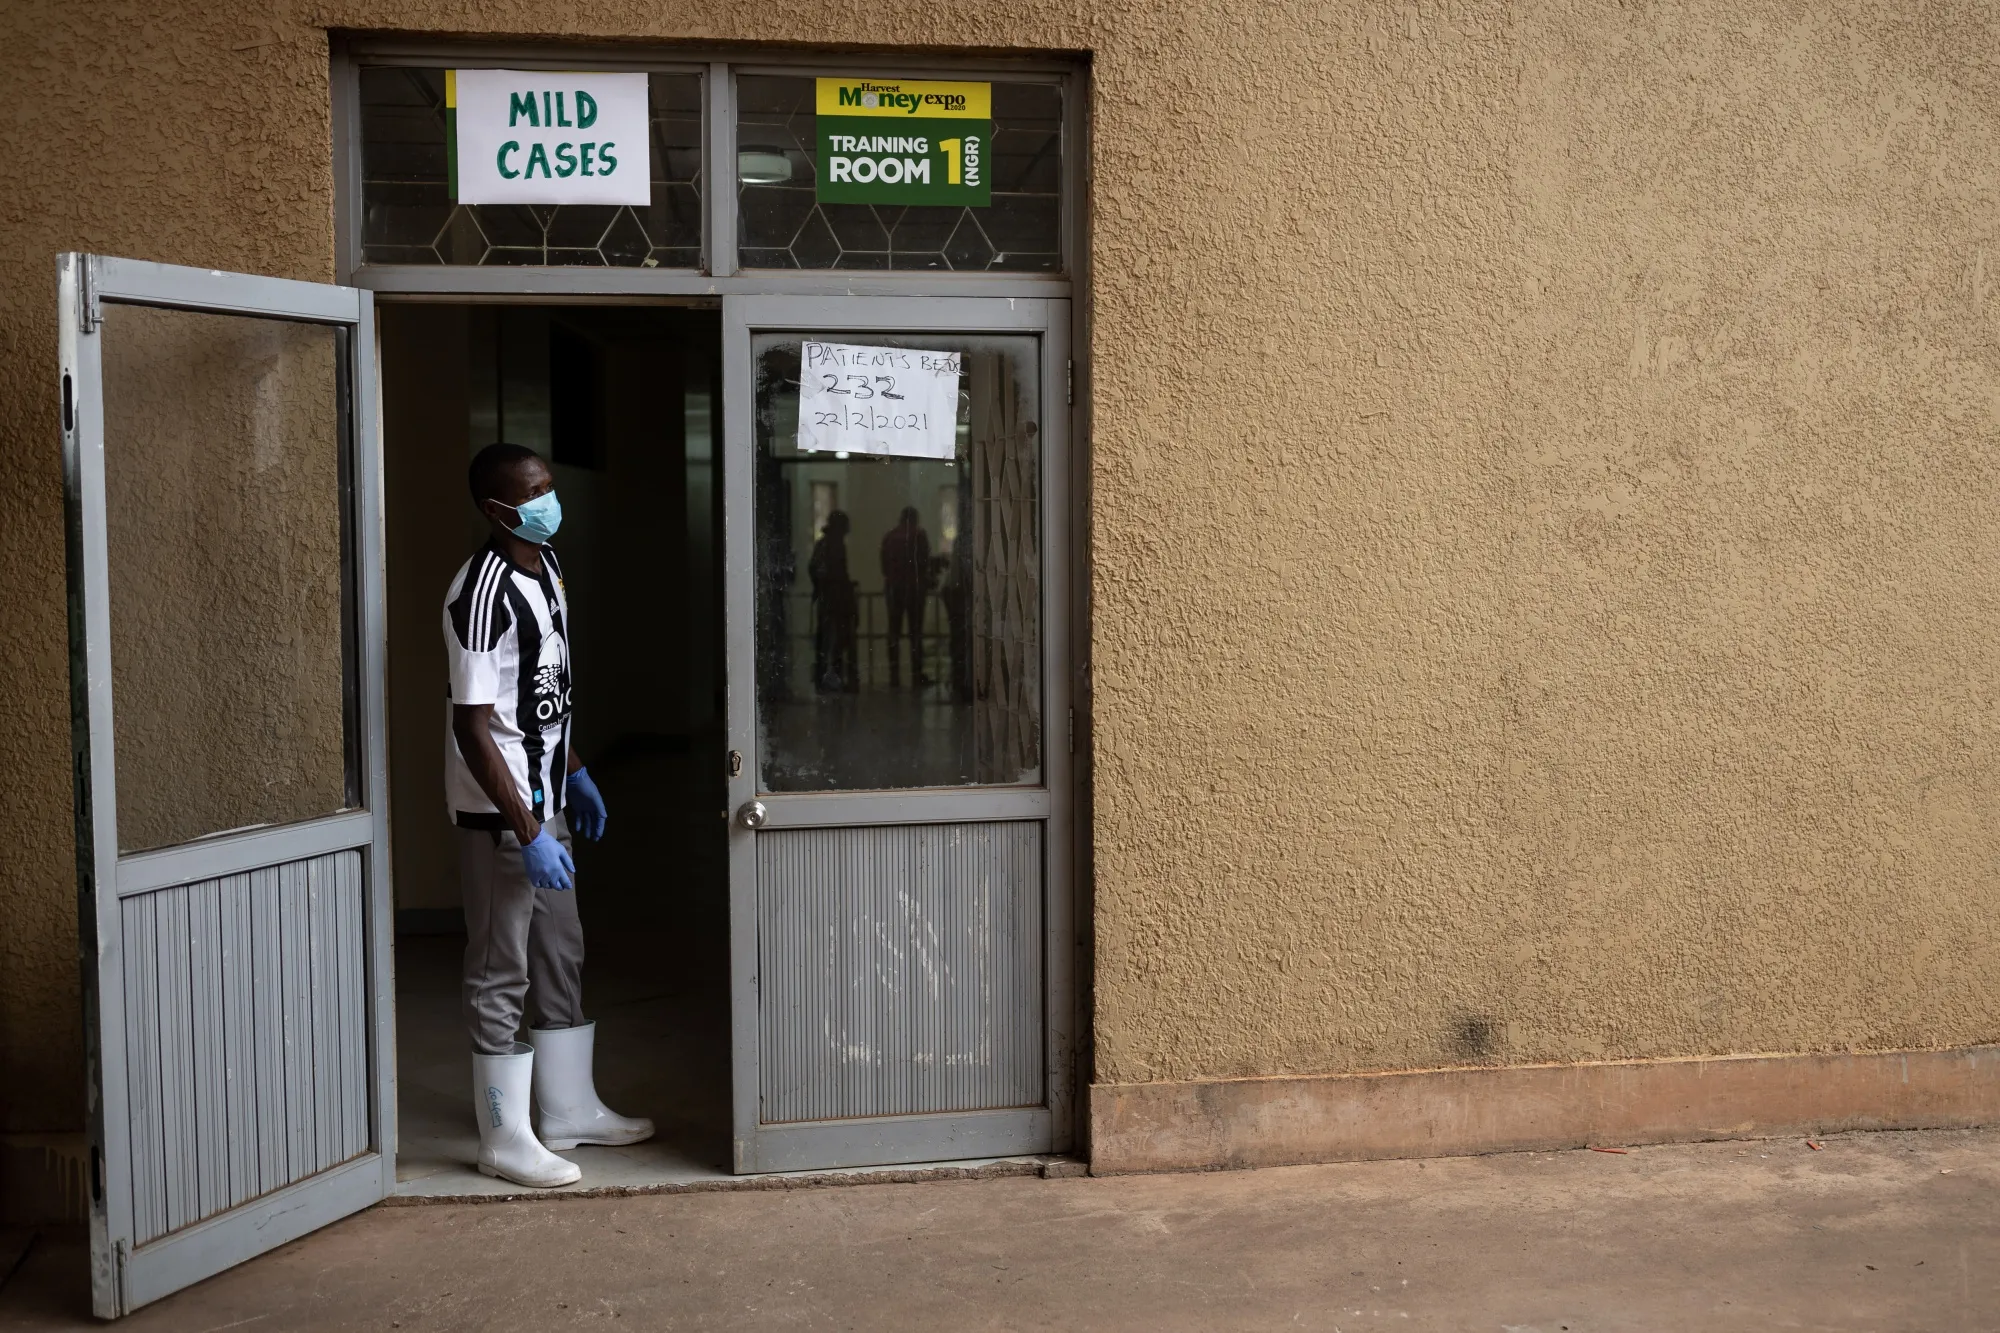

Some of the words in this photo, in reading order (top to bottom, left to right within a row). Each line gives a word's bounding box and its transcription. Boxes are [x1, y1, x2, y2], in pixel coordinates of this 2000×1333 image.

[838, 86, 924, 115] Money
[924, 92, 966, 111] expo
[860, 82, 901, 93] Harvest
[508, 90, 598, 130] MILD
[828, 135, 929, 154] TRAINING
[496, 140, 618, 180] CASES
[829, 156, 931, 184] ROOM
[938, 138, 961, 184] 1
[964, 135, 981, 187] (NGR)
[805, 342, 911, 370] PATIENTS
[822, 373, 905, 401] 232
[814, 404, 928, 431] 22/2/2021
